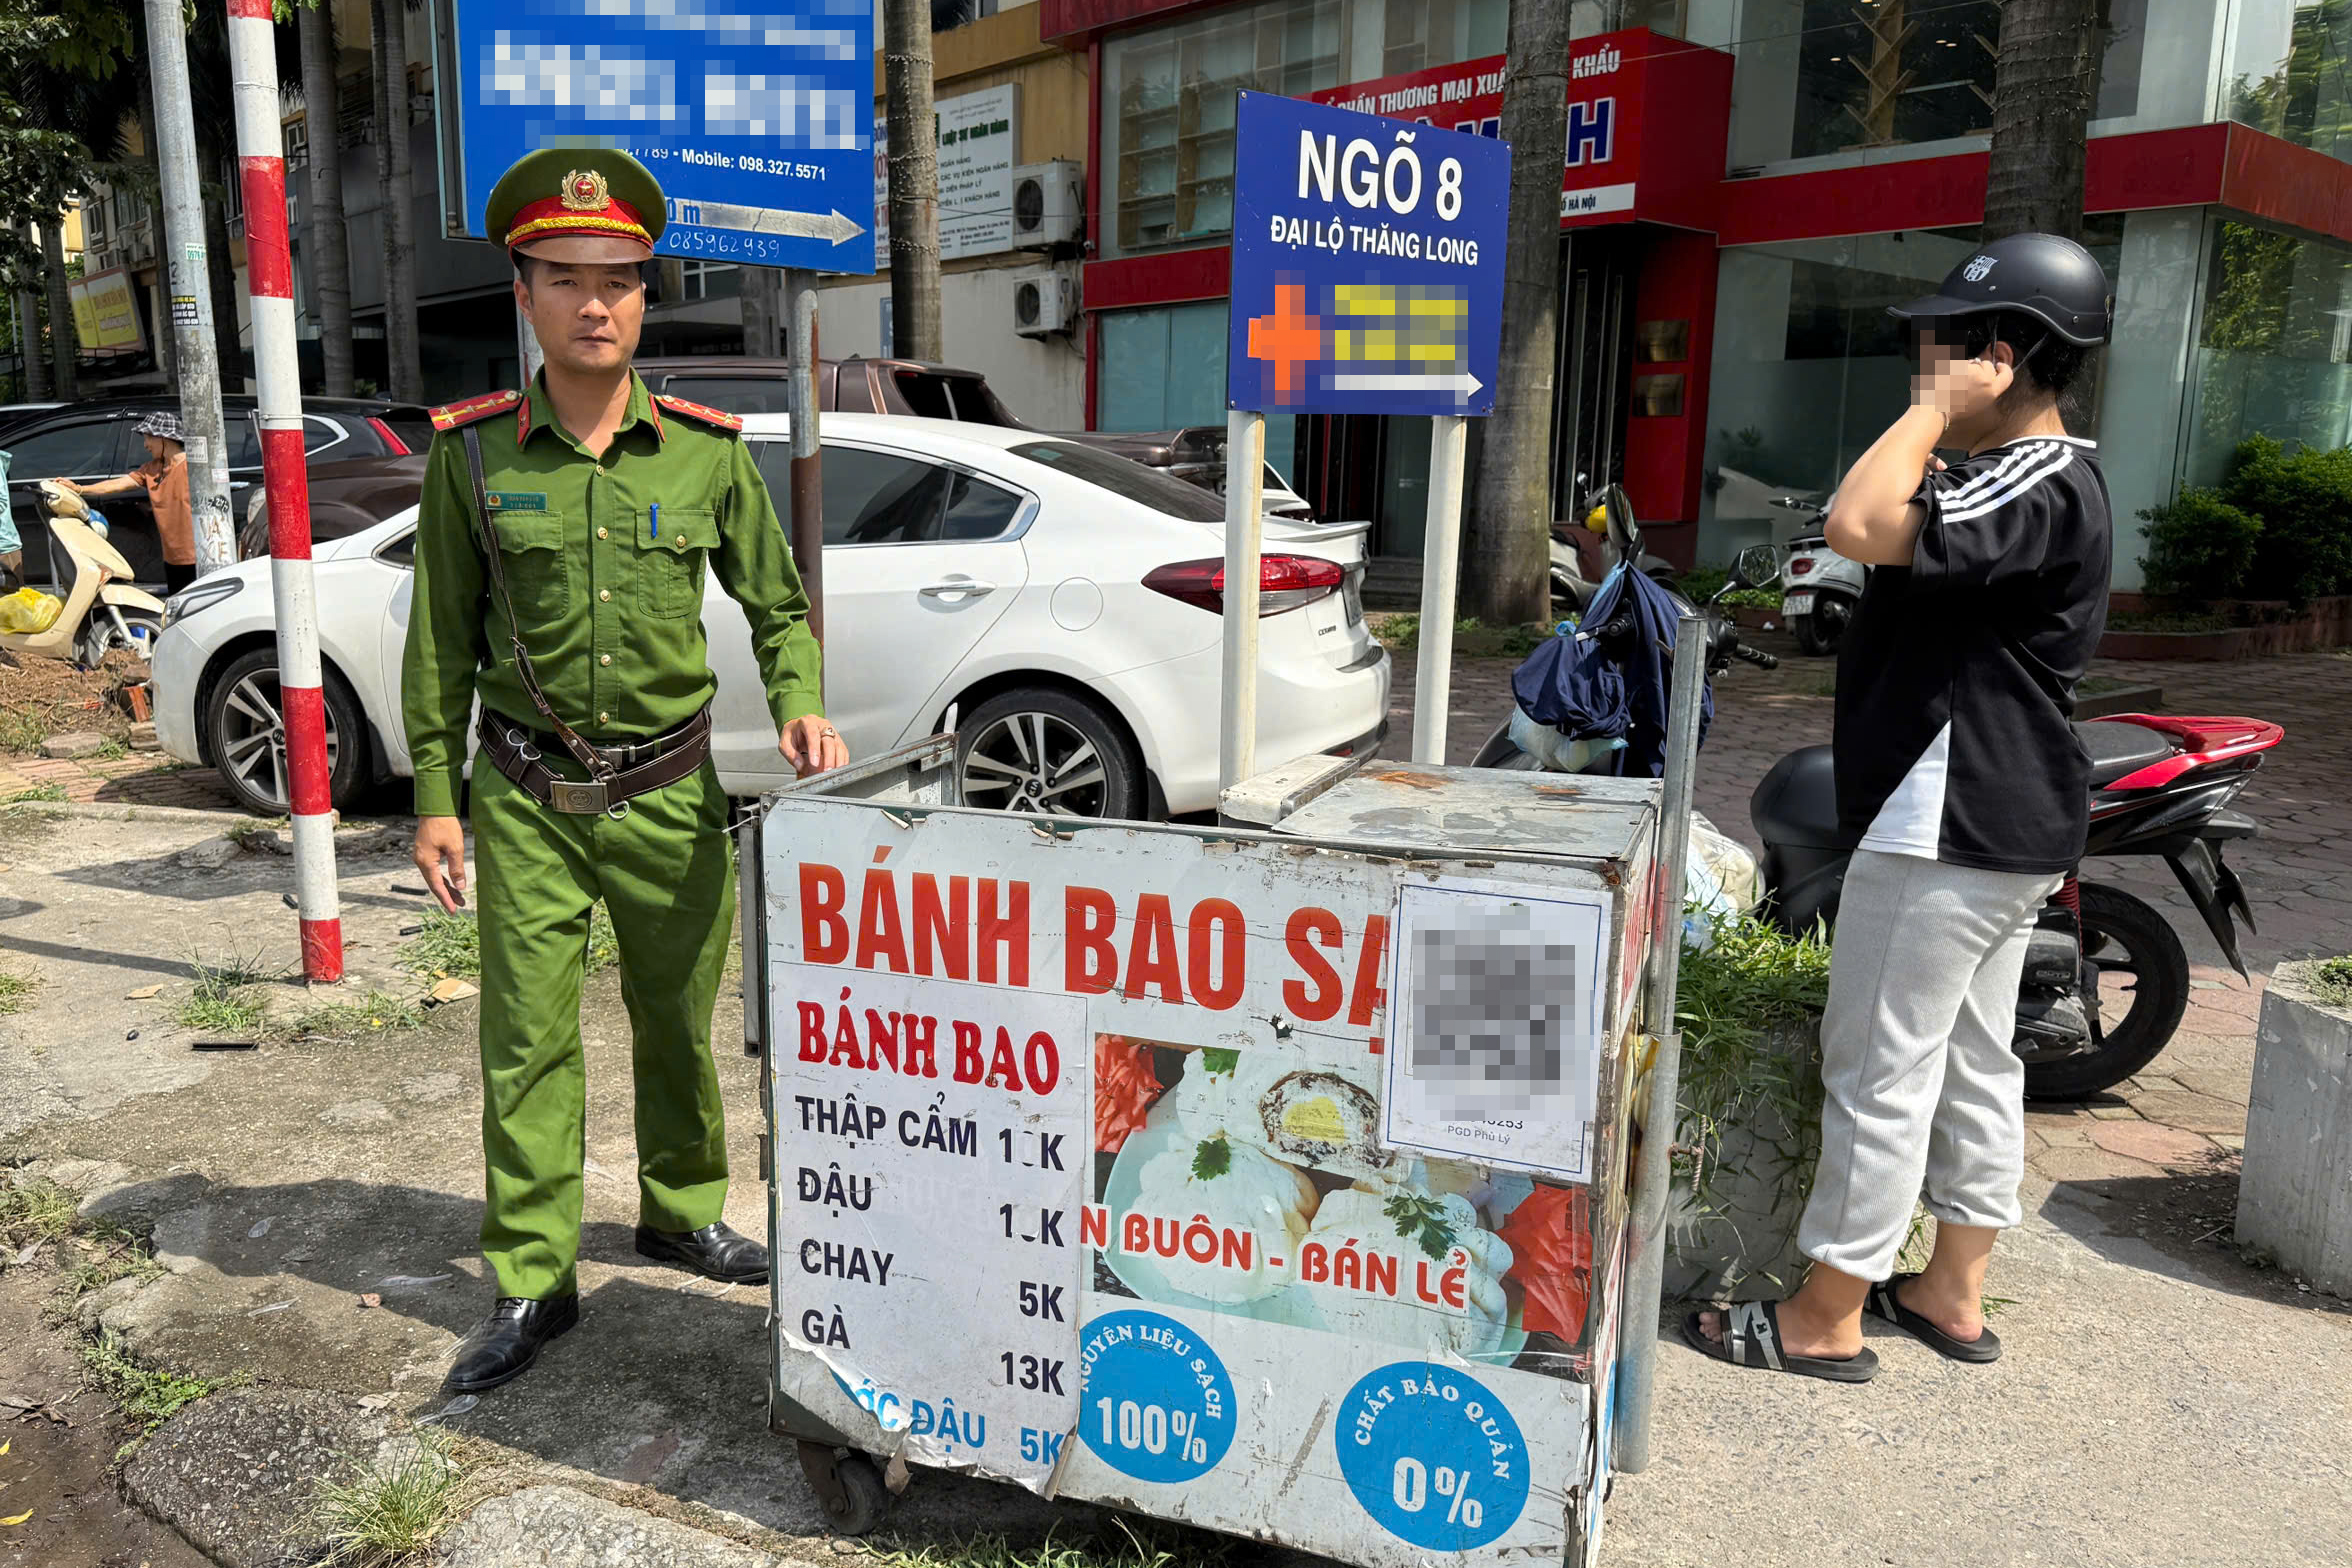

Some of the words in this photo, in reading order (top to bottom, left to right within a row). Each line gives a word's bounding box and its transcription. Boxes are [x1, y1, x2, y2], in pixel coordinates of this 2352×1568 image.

[1379, 84, 1438, 113] THƯƠNG
[1441, 78, 1472, 104] MẠI
[1573, 43, 1621, 79] KHẨU
[682, 149, 734, 169] Mobile:
[739, 155, 826, 182] 098.327.5571
[1298, 129, 1422, 215] NGÕ
[1435, 157, 1463, 222] 8
[1270, 215, 1308, 250] ĐẠI
[1314, 216, 1344, 255] LỘ
[1349, 222, 1420, 259] THĂNG
[1425, 235, 1479, 266] LONG
[798, 845, 1031, 988] BÁNH
[1064, 885, 1247, 1011] BAO
[796, 985, 939, 1079] BÁNH
[952, 1019, 1060, 1096] BAO
[795, 1092, 887, 1149] THẬP
[898, 1091, 977, 1157] CẨM
[999, 1128, 1065, 1172] 1K
[1447, 1125, 1471, 1137] PGD
[797, 1161, 873, 1218] ĐẬU
[999, 1203, 1065, 1248] 1K
[800, 1238, 894, 1287] CHAY
[1019, 1280, 1065, 1323] 5K
[1124, 1213, 1252, 1271] BUÔN
[1301, 1238, 1398, 1298] BÁN
[1416, 1246, 1466, 1308] LẺ
[801, 1304, 851, 1350] GÀ
[1001, 1351, 1065, 1396] 13K
[1139, 1325, 1192, 1357] LIỆU
[1190, 1358, 1222, 1420] SẠCH
[910, 1397, 986, 1453] ĐẬU
[1020, 1426, 1065, 1466] 5K
[1096, 1396, 1208, 1464] 100%
[1354, 1385, 1396, 1446] CHẤT
[1464, 1401, 1514, 1480] QUẢN
[1393, 1456, 1484, 1529] 0%
